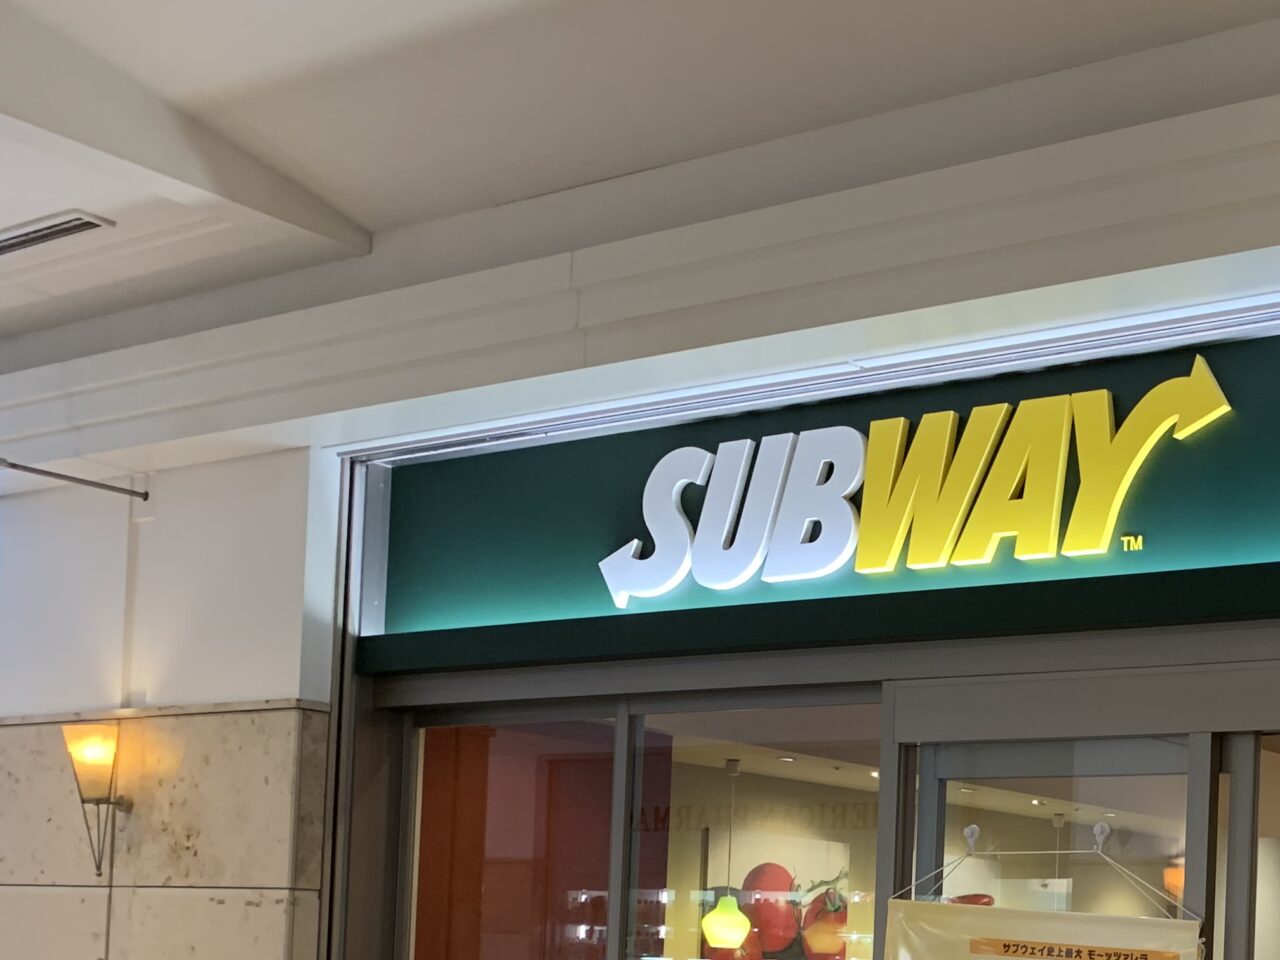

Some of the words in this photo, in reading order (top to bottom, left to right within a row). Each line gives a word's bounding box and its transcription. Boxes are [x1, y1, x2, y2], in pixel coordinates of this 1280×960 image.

[599, 354, 1231, 609] SUBWAY
[1121, 534, 1143, 553] TM
[1003, 943, 1083, 959] サブウェイ史上最大
